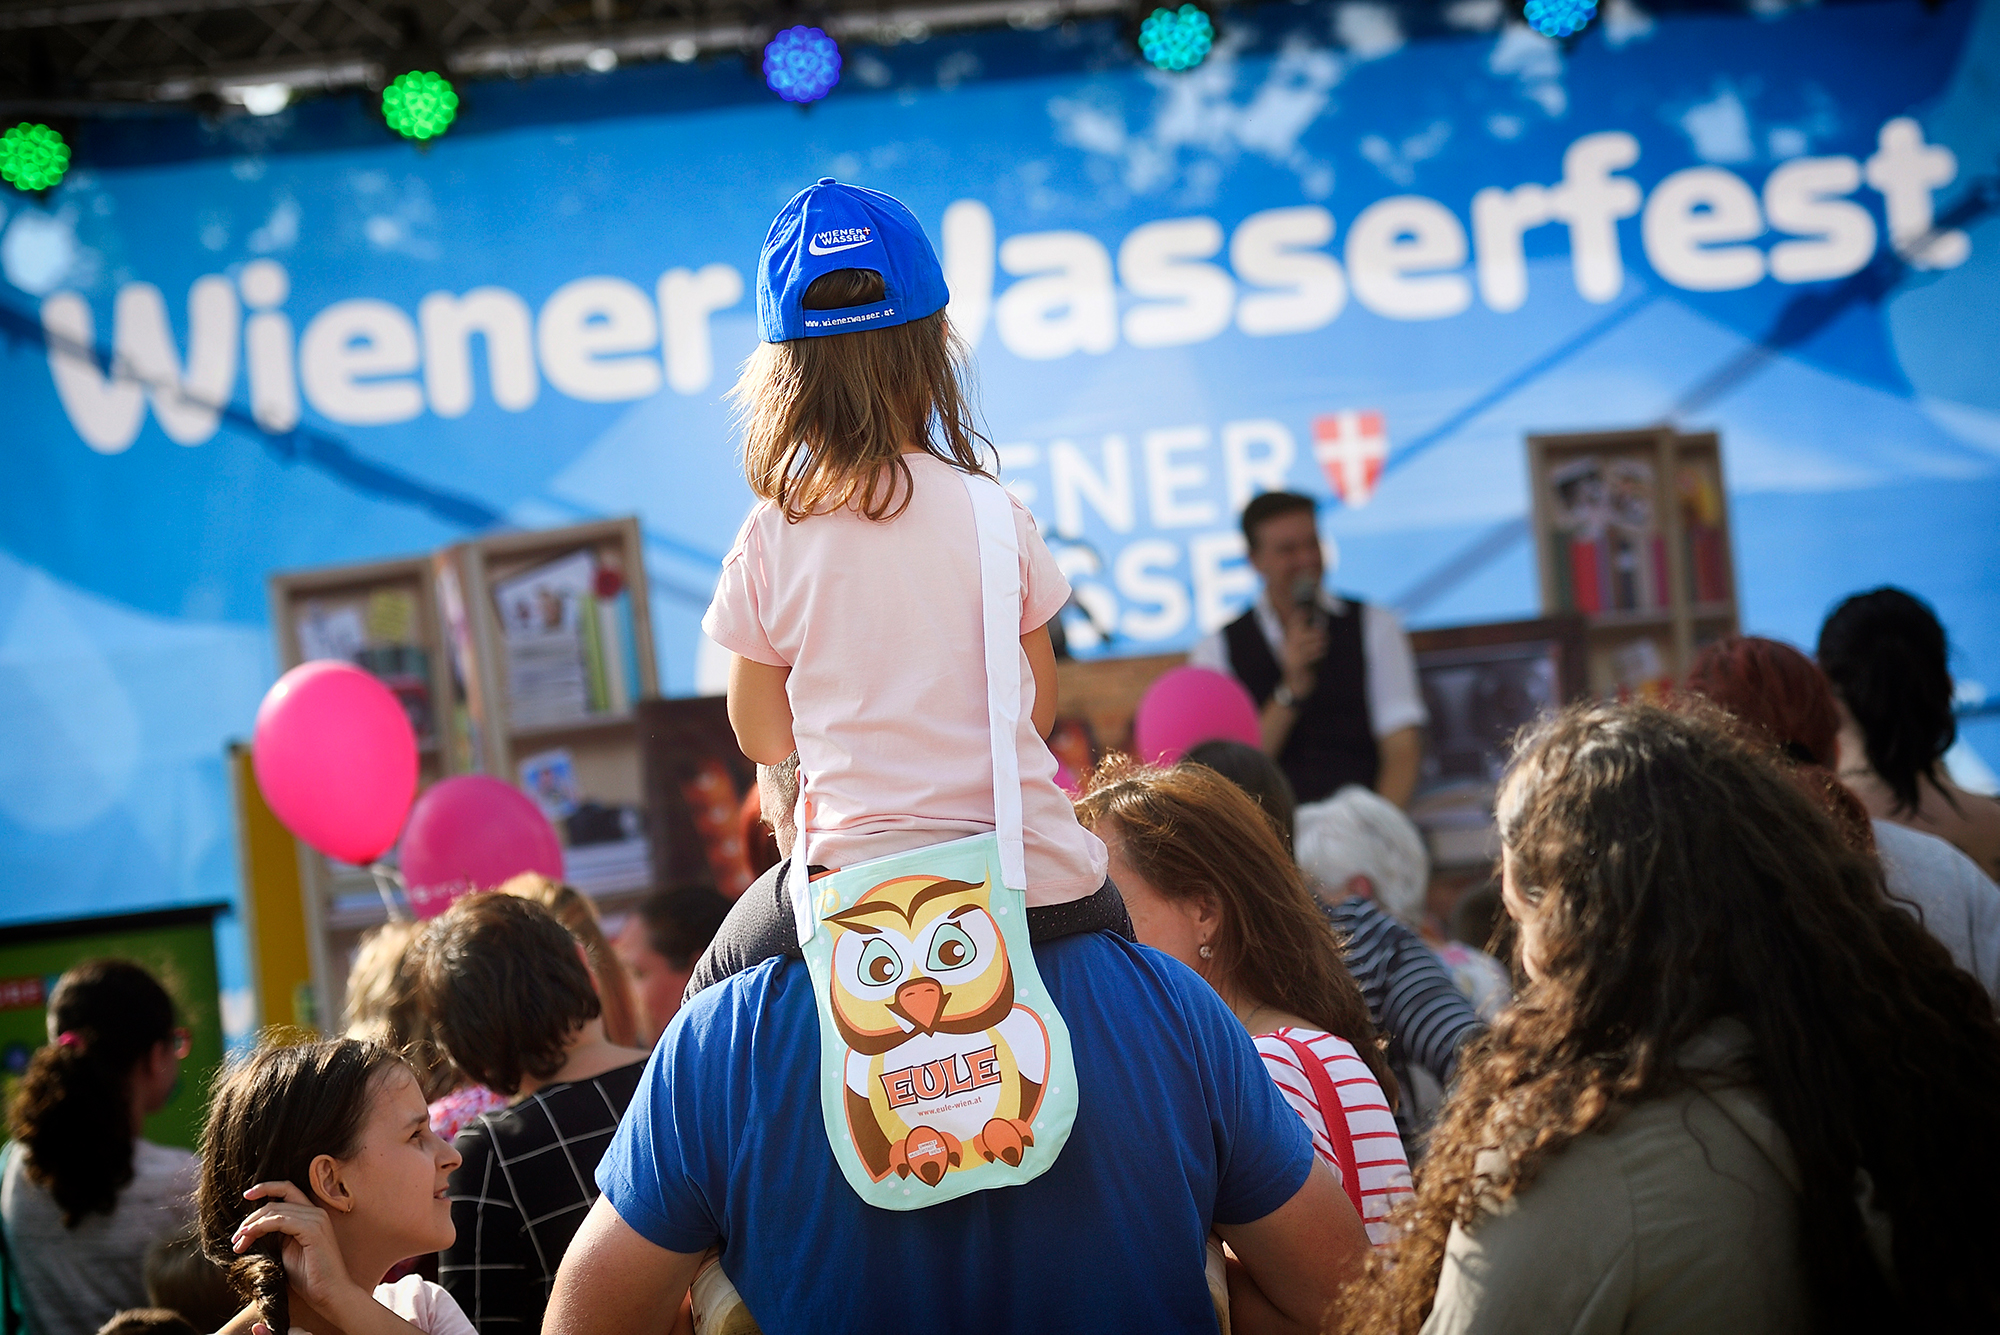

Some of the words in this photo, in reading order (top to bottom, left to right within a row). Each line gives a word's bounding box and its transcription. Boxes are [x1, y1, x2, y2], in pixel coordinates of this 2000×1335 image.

[818, 228, 863, 240] WIENER
[822, 234, 867, 246] WASSER
[40, 260, 743, 455] Wiener
[878, 1044, 1003, 1111] EULE
[917, 1096, 983, 1117] www.eule-wien.at
